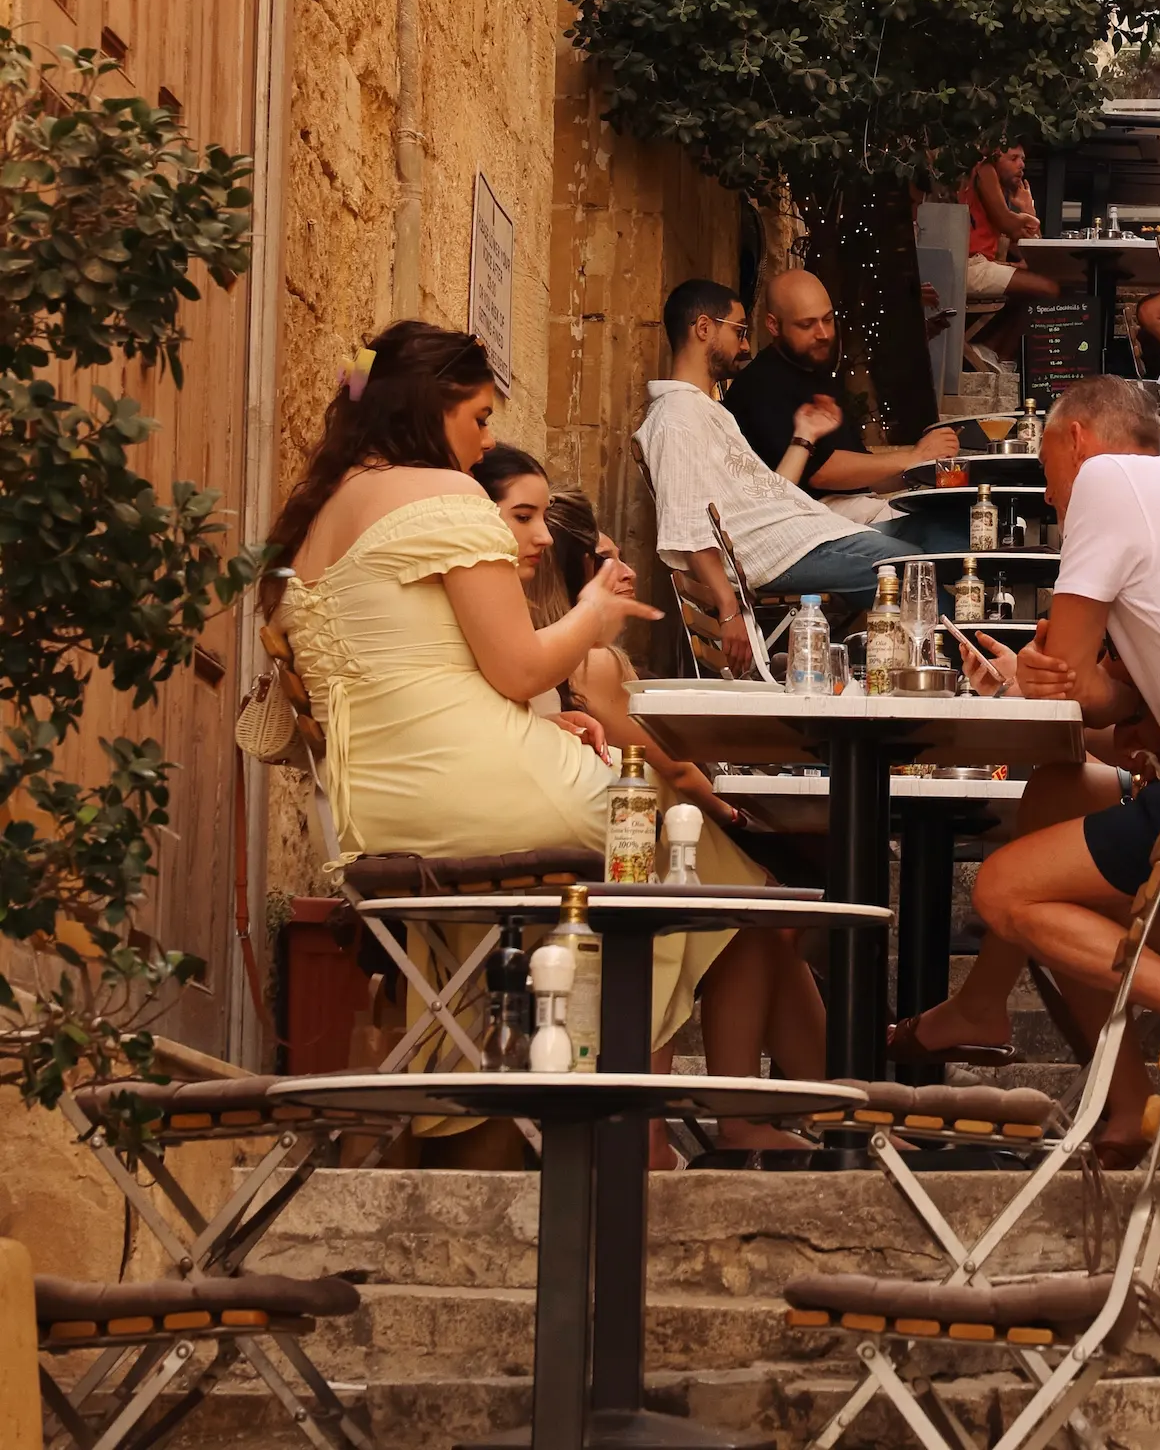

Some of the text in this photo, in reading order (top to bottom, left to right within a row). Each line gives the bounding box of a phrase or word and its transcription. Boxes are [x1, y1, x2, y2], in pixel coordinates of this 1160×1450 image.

[483, 244, 503, 285] VOICE AFTER
[501, 246, 510, 272] YOUR
[491, 301, 499, 323] RISK
[1036, 303, 1080, 314] Special Cocktails
[478, 305, 491, 336] GETTING
[492, 325, 503, 350] FINED
